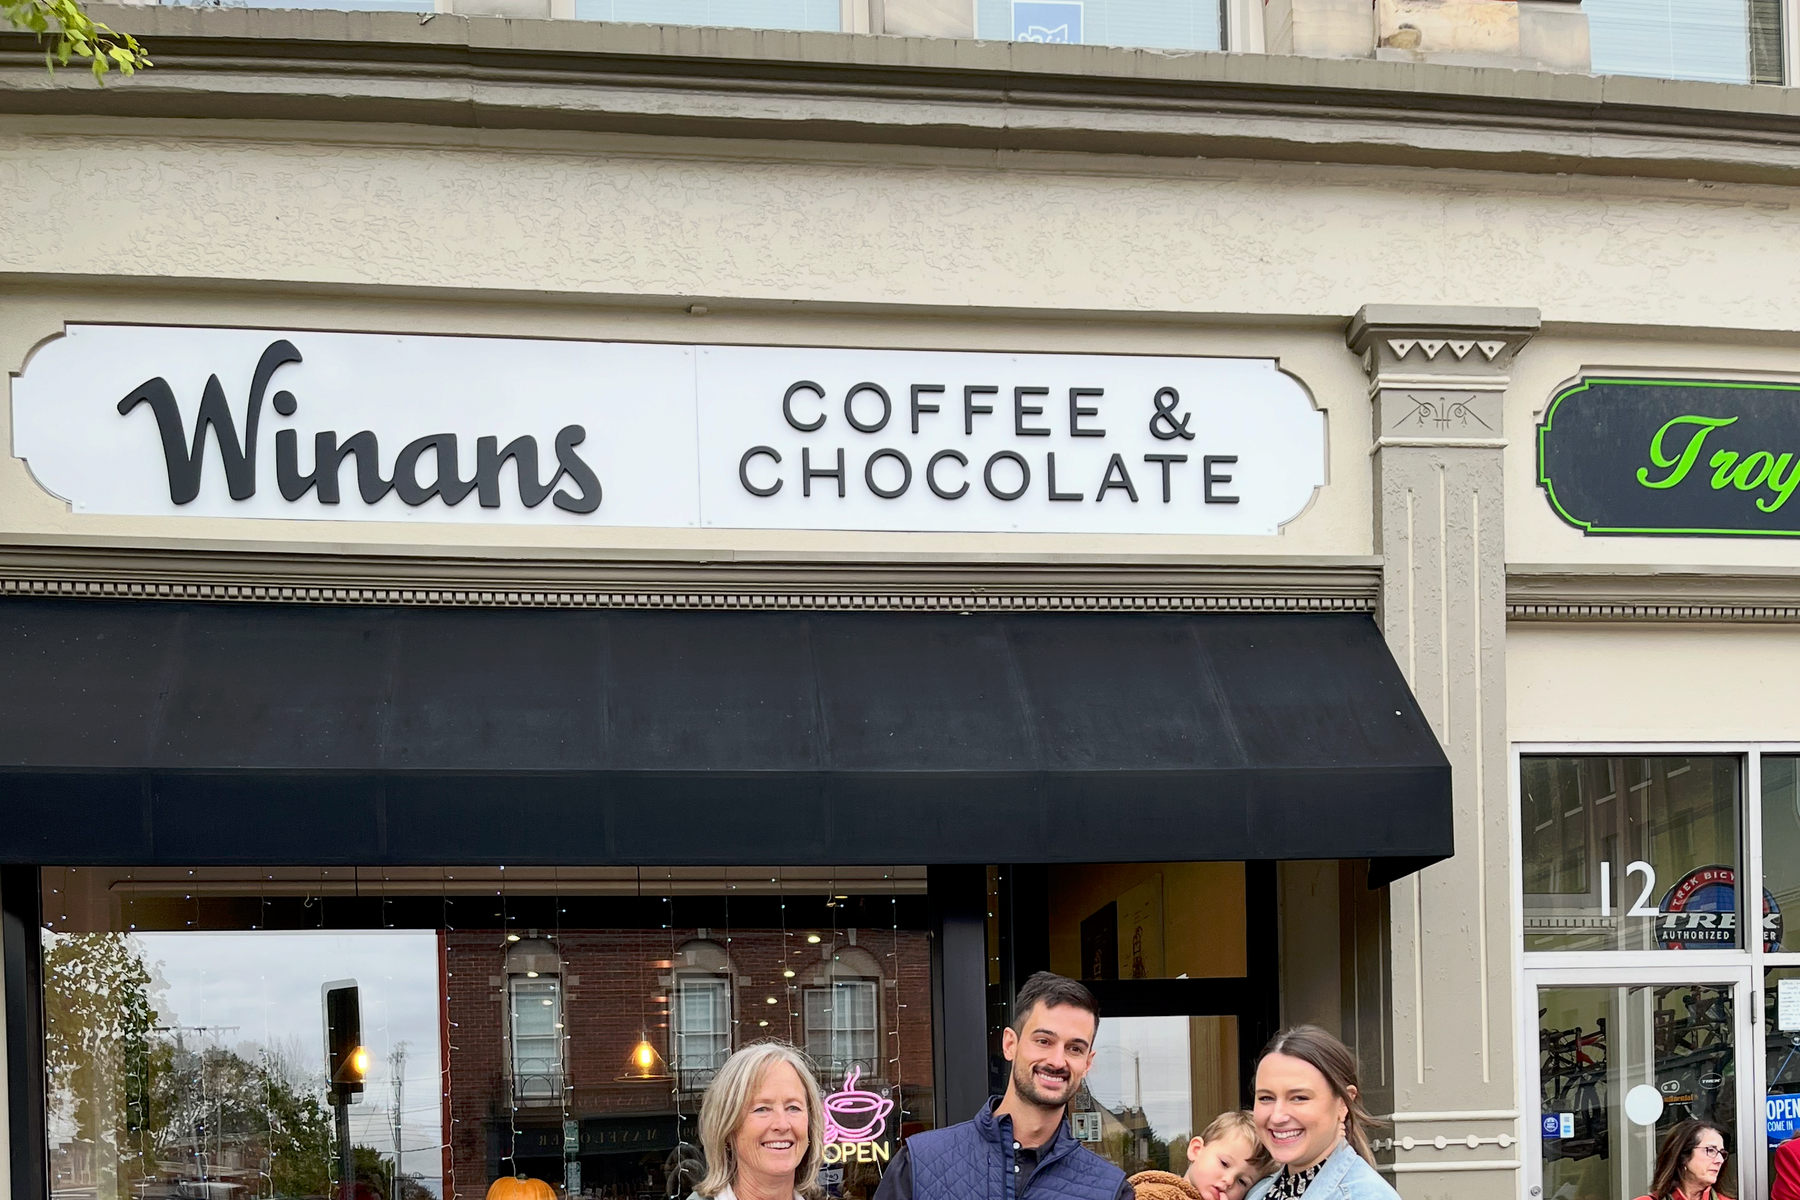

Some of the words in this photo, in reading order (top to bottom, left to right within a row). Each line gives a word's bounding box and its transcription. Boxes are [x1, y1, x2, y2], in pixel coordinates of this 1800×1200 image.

[117, 339, 602, 514] Winans
[782, 380, 1107, 438] COFFEE
[1148, 386, 1197, 441] &
[738, 446, 1241, 504] CHOCOLATE
[1636, 415, 1800, 513] Troy
[1601, 861, 1660, 917] 12
[1673, 877, 1699, 907] TREK
[1704, 870, 1735, 881] BICY
[1662, 931, 1730, 940] AUTHORIZED
[1766, 1098, 1800, 1120] OPEN
[1768, 1121, 1785, 1131] COME
[1786, 1120, 1793, 1130] IN
[822, 1141, 890, 1163] OPEN
